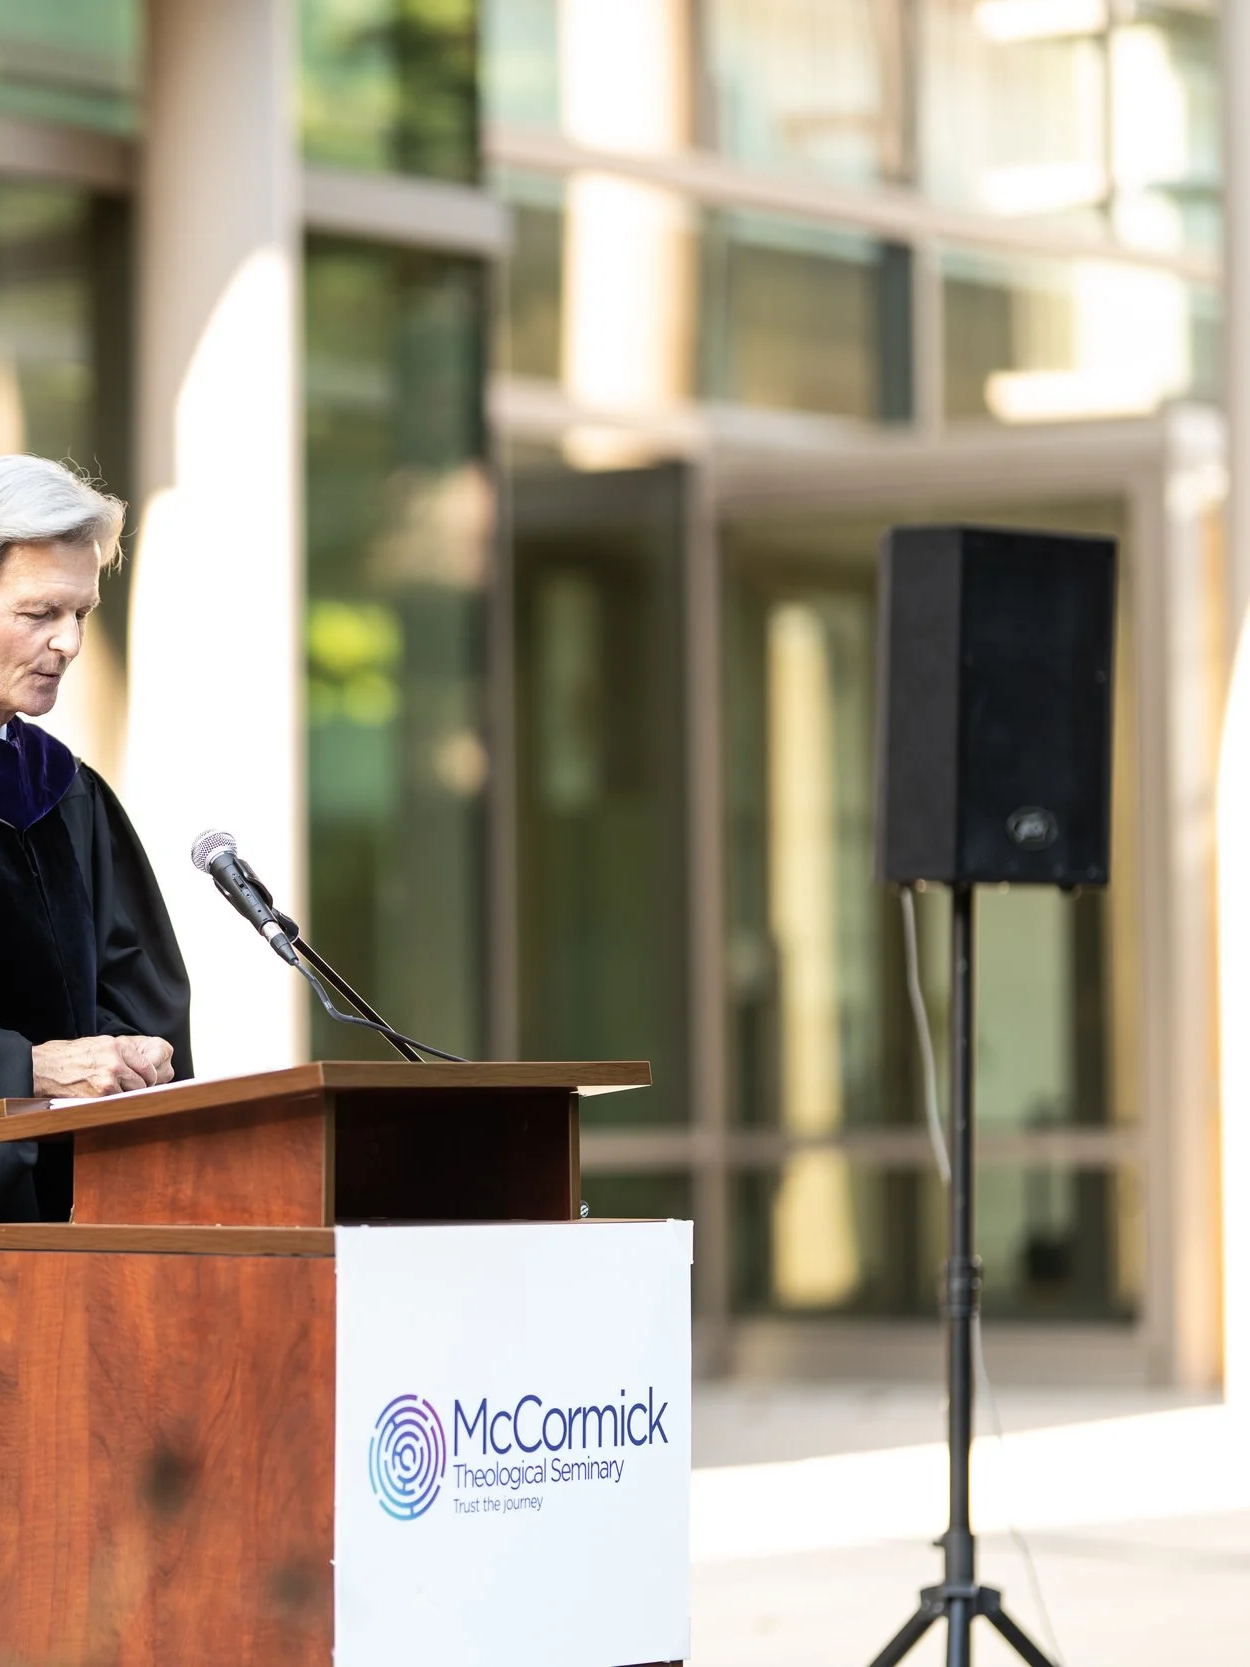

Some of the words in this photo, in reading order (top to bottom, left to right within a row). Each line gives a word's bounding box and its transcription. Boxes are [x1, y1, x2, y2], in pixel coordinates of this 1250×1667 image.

[454, 1386, 669, 1457] McCormick
[453, 1459, 547, 1490] Theological
[550, 1456, 625, 1483] Seminary
[453, 1498, 480, 1514] Trust
[482, 1496, 501, 1512] the
[502, 1495, 544, 1513] journey
